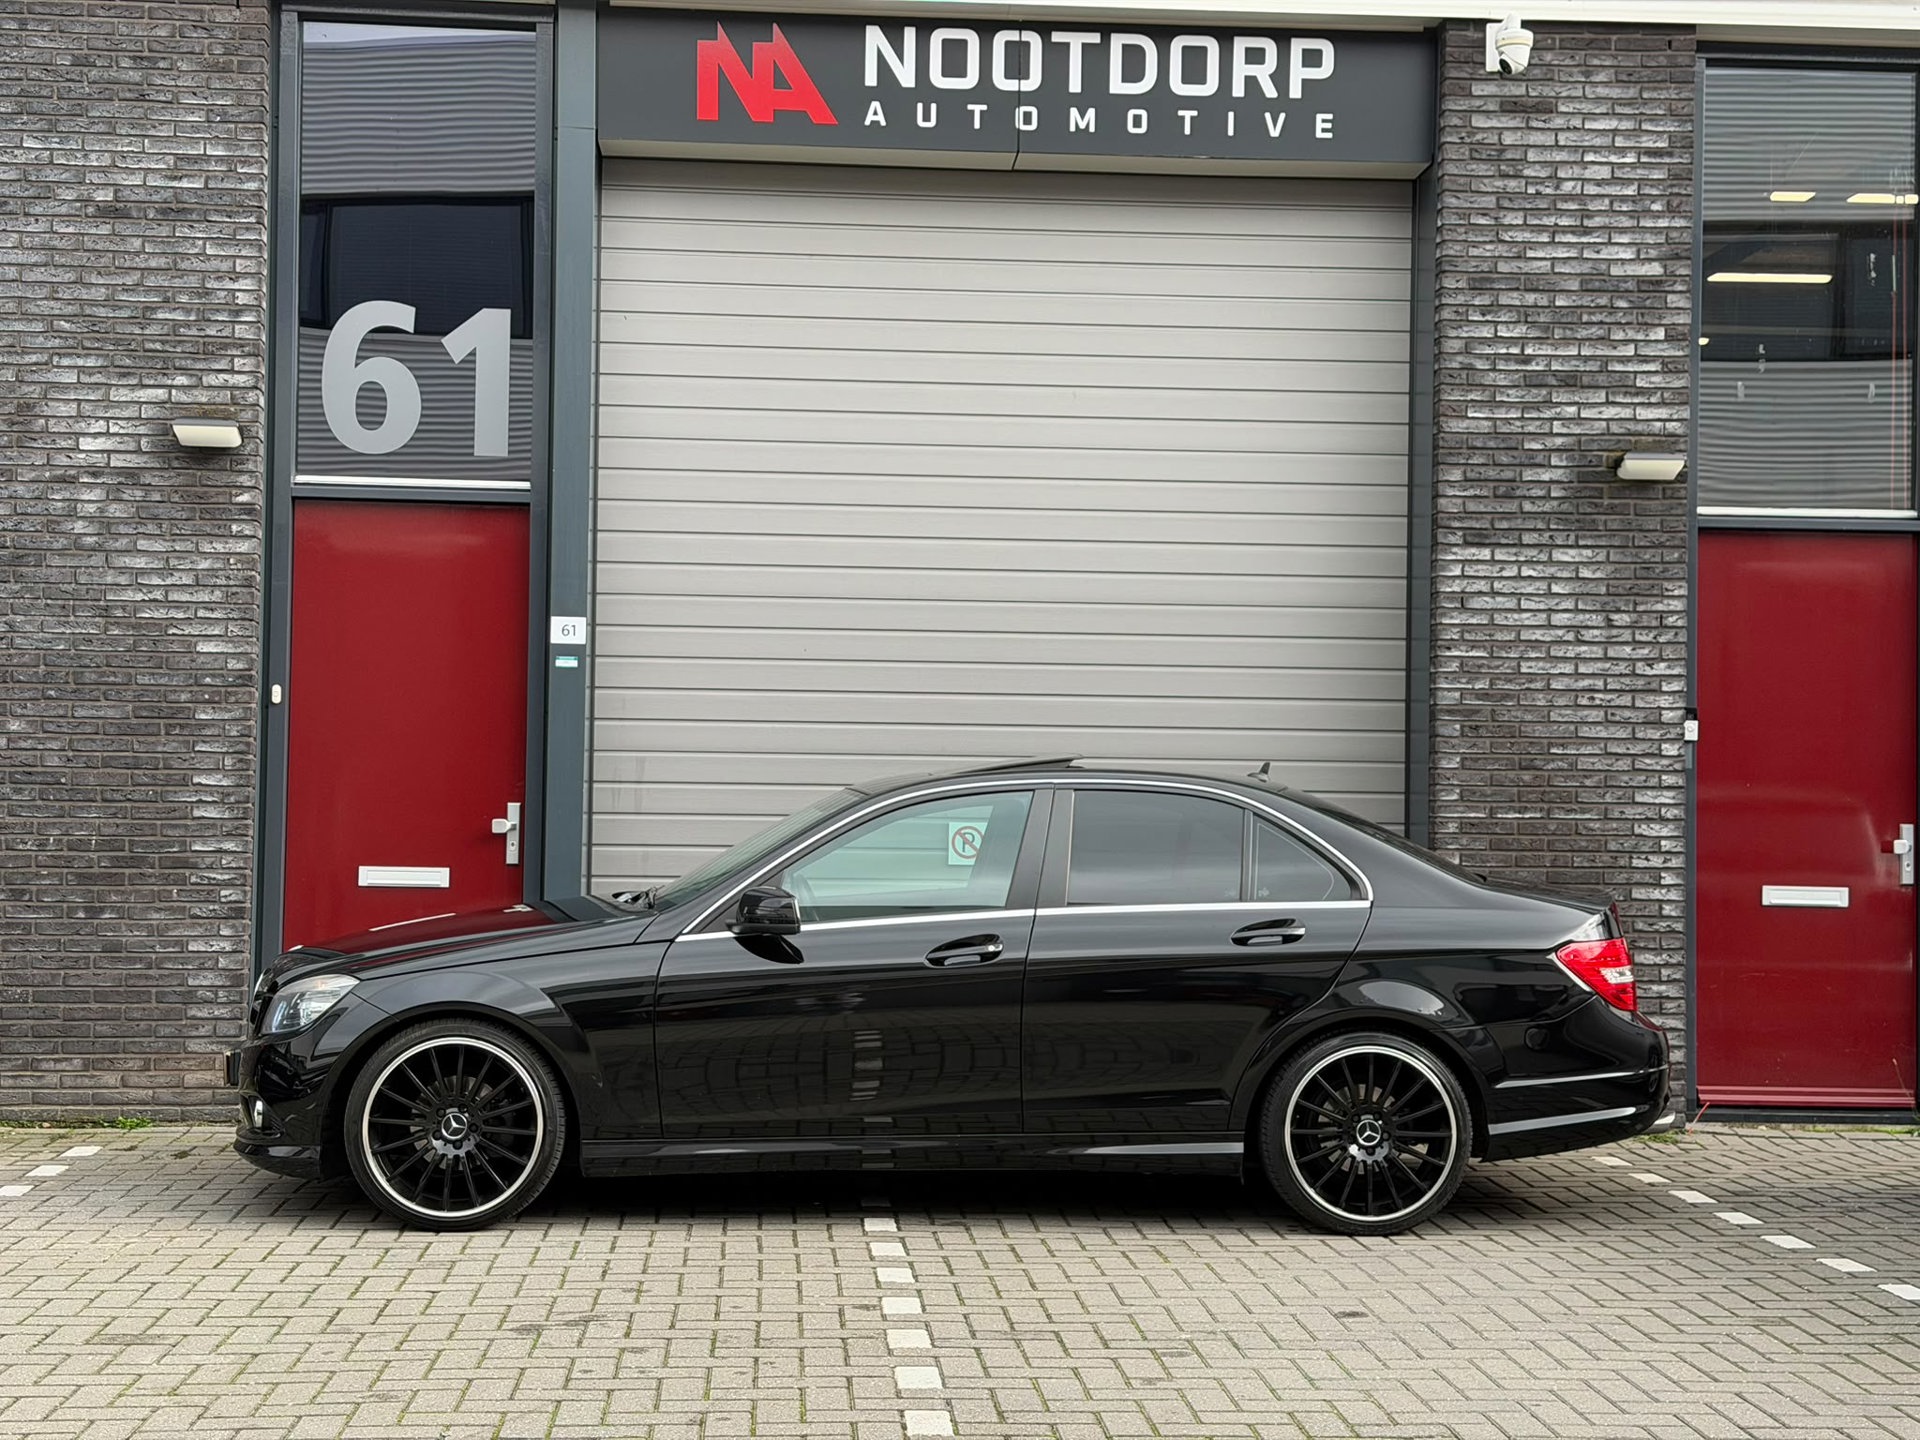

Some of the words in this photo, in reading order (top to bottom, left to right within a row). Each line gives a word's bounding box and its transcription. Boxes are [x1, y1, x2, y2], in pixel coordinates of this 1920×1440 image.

[696, 22, 838, 125] NA
[864, 25, 1335, 99] NOOTDORP
[864, 101, 1333, 139] AUTOMOTIVE
[321, 300, 511, 456] 61
[561, 624, 576, 637] 61
[962, 832, 975, 853] P
